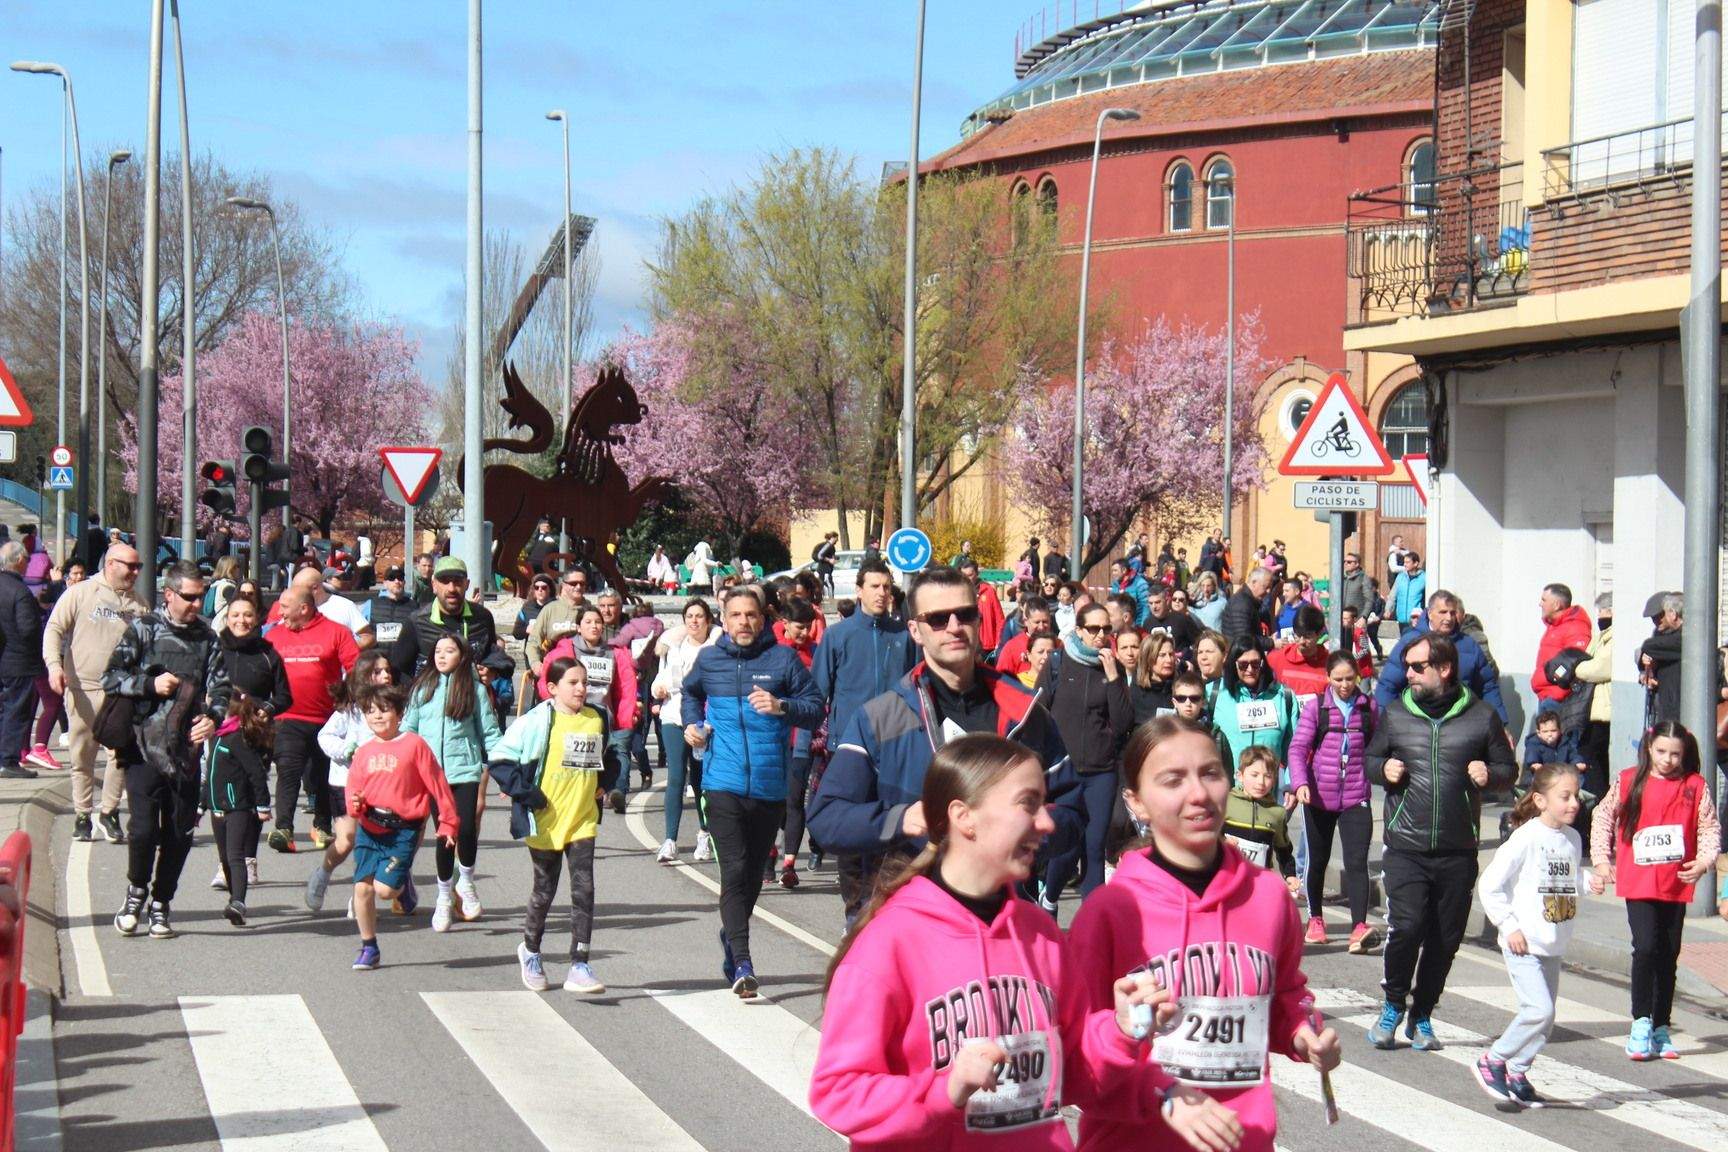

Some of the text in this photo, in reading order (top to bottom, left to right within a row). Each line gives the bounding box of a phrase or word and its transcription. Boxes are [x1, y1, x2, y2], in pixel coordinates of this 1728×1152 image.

[1312, 486, 1342, 494] PASO
[1306, 497, 1365, 506] CICLISTAS
[587, 662, 607, 670] 3004
[1248, 707, 1267, 717] 2057
[1644, 834, 1672, 847] 2753
[1548, 862, 1570, 876] 3599
[1185, 1013, 1246, 1043] 2491
[994, 1050, 1044, 1085] 2490
